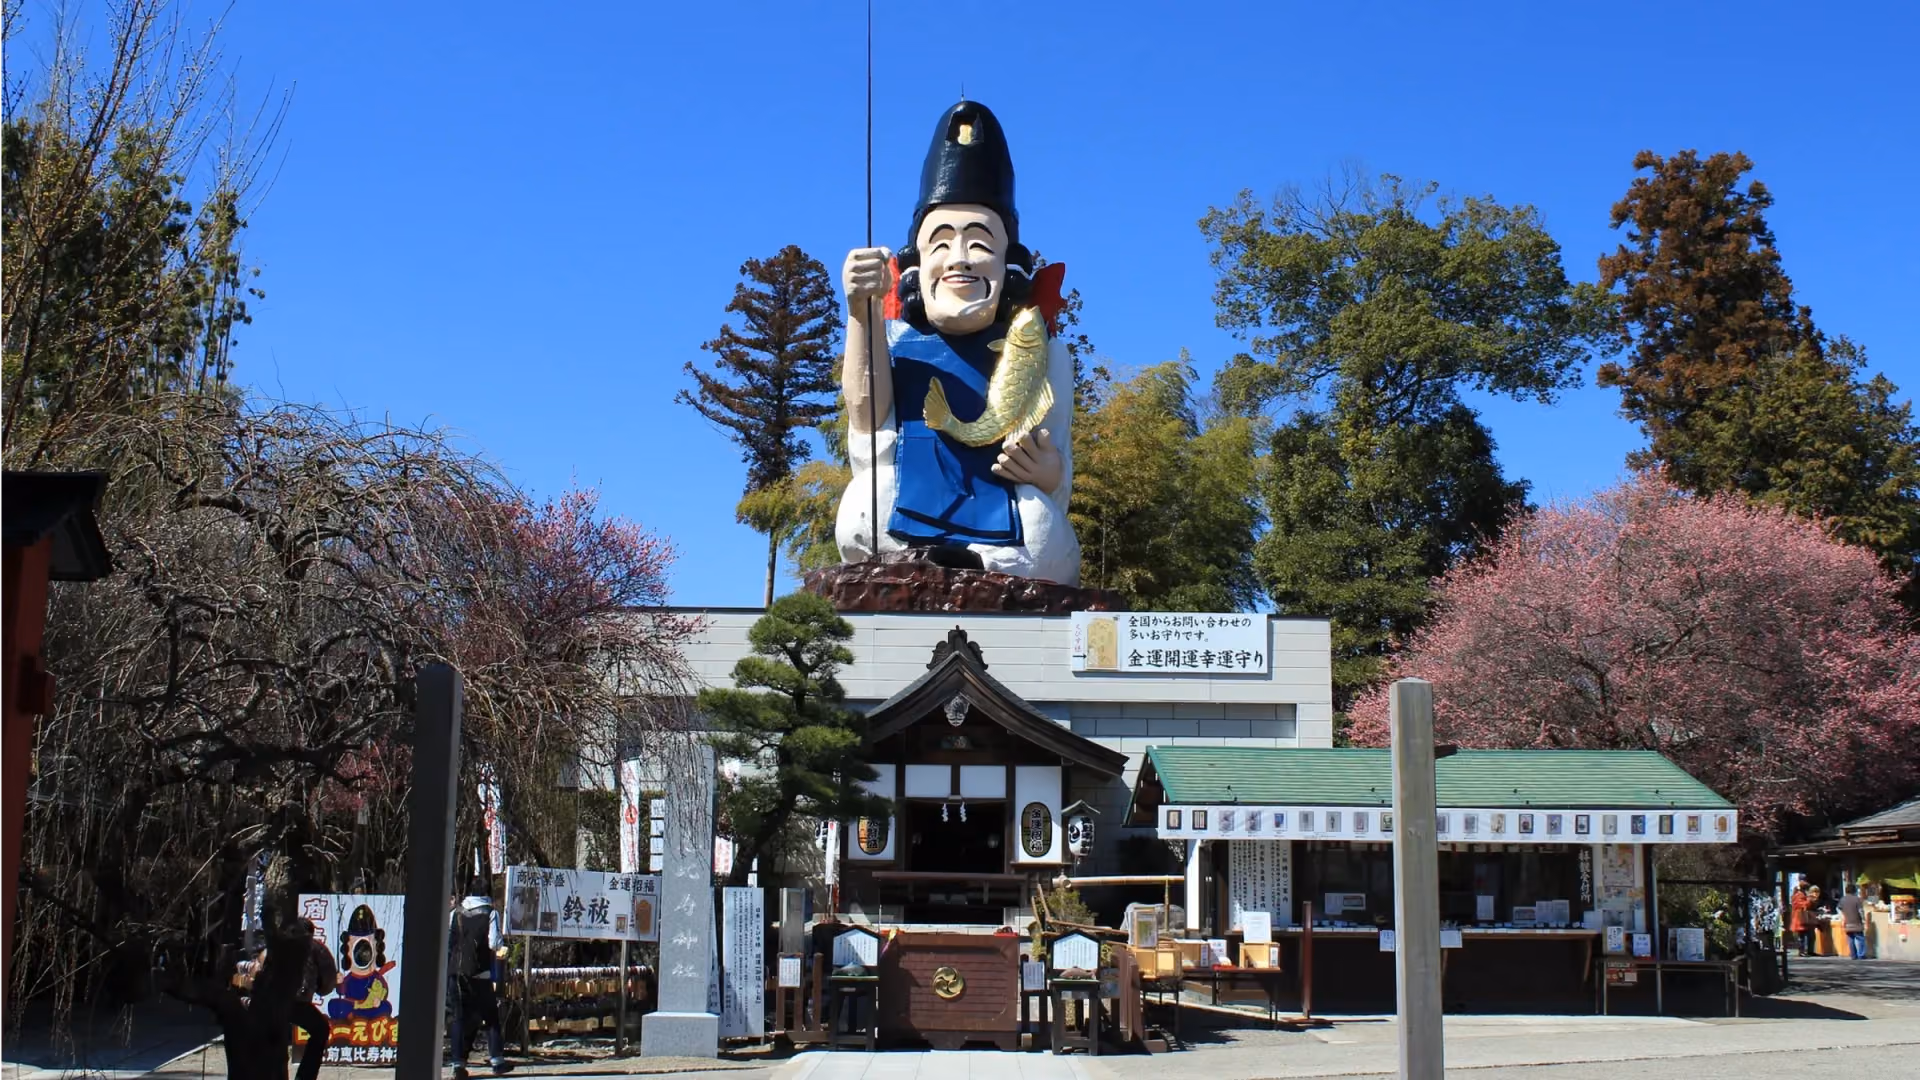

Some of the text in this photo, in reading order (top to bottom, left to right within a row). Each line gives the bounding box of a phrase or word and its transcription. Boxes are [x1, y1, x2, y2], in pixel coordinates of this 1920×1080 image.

[1128, 615, 1252, 628] 全国からお問い合わせの
[1129, 628, 1209, 642] 多いお守りです。
[1127, 648, 1264, 669] 金運開運幸運守り
[608, 876, 656, 893] 金運招福
[562, 895, 611, 925] 鈴祓
